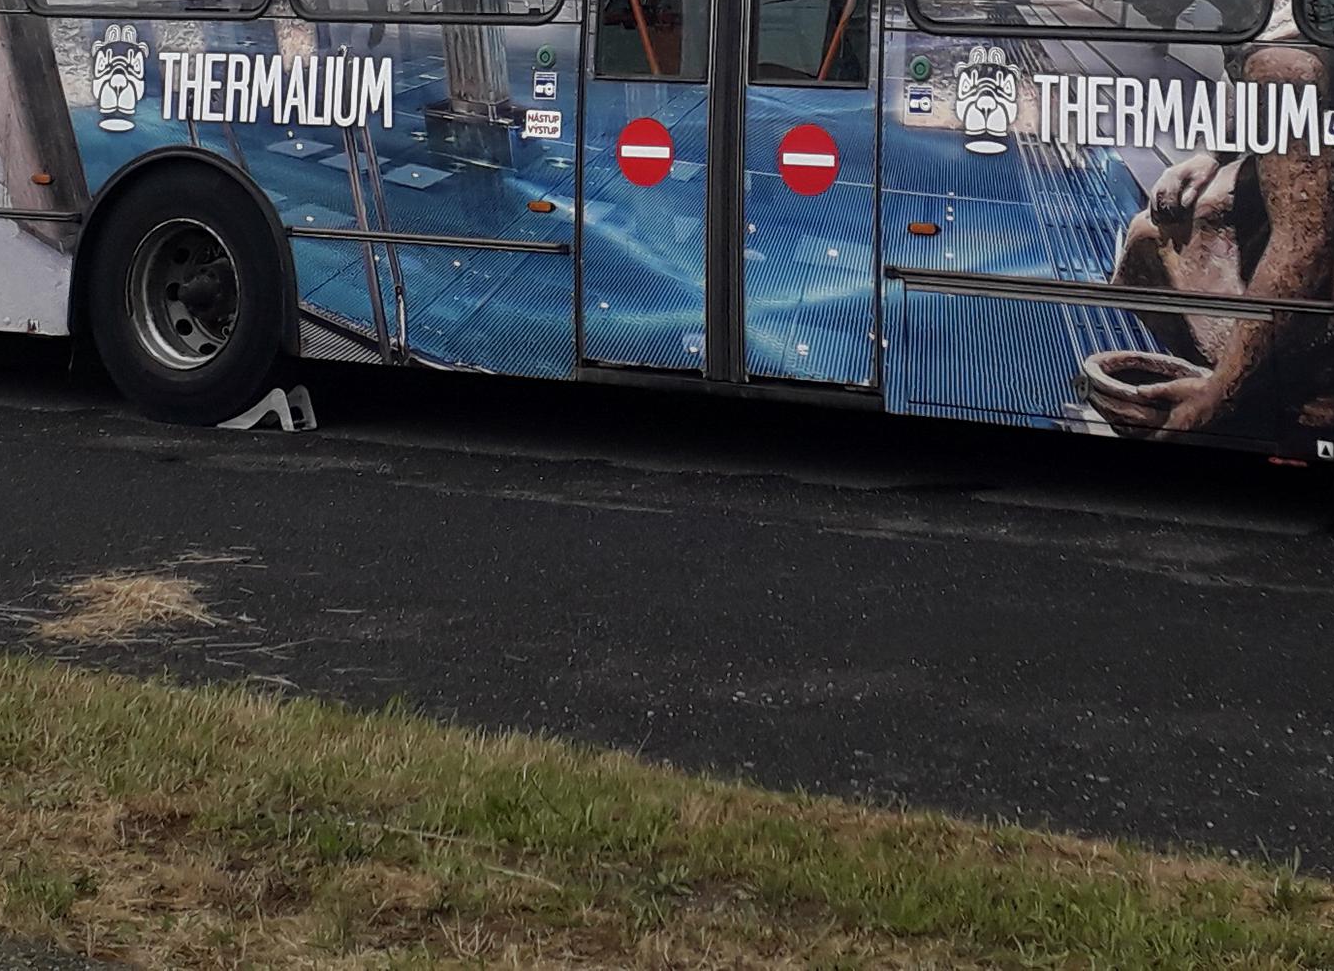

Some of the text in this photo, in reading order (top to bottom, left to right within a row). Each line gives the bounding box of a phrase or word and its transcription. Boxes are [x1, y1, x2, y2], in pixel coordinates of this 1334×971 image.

[159, 52, 393, 128] THERMALIUM
[527, 112, 560, 123] NÁSTUP
[527, 123, 560, 135] VÝSTUP
[1033, 74, 1321, 157] THERMALIUM
